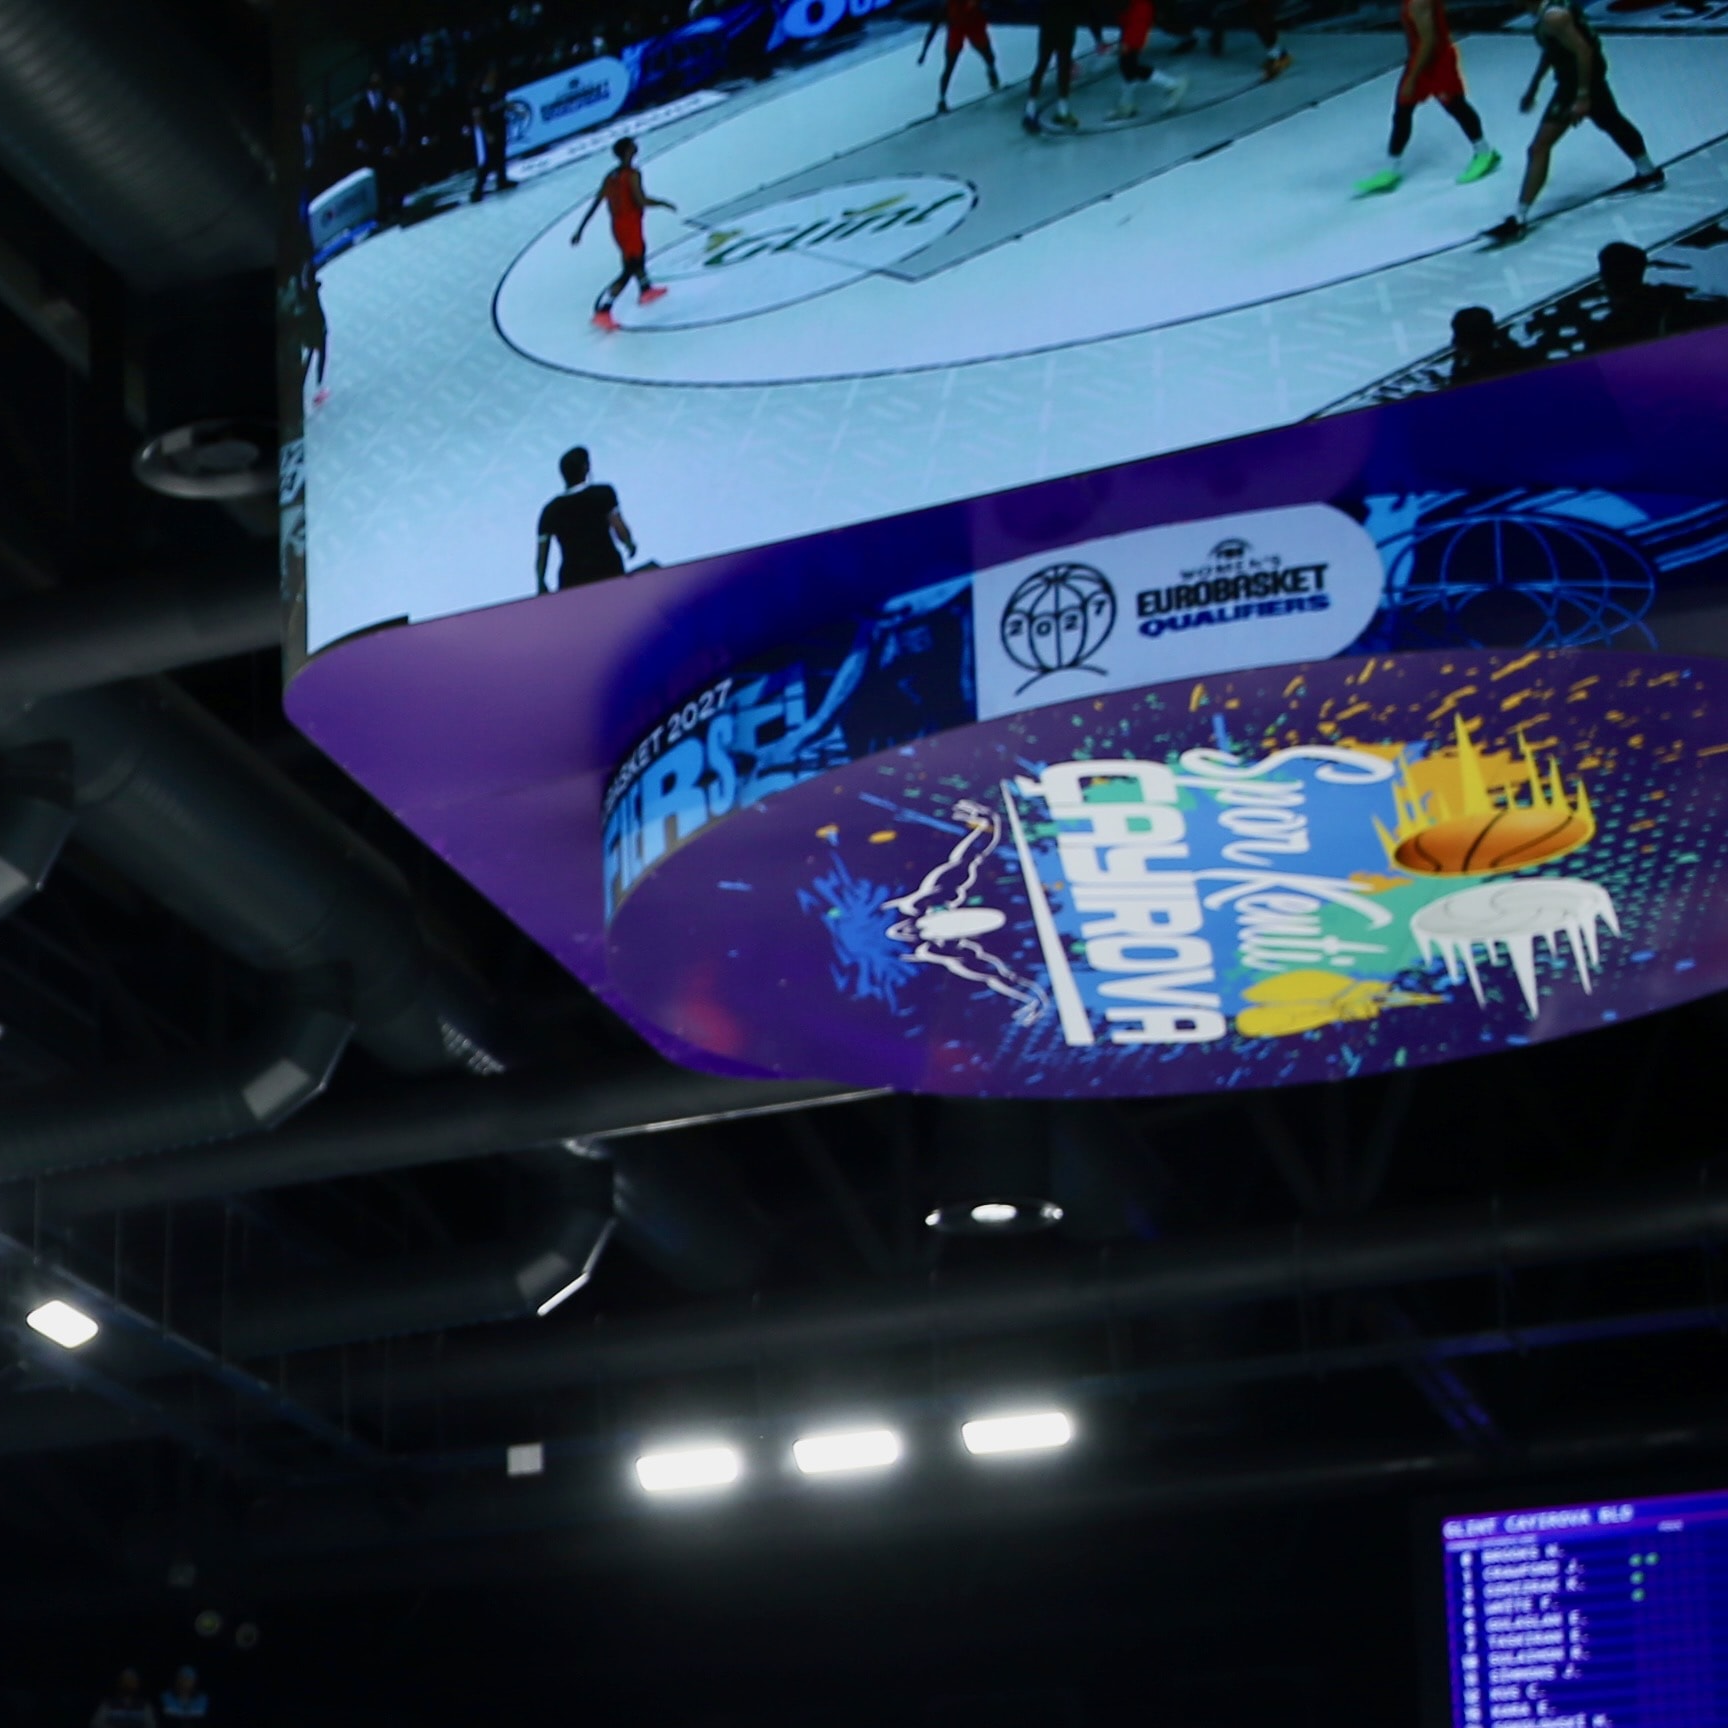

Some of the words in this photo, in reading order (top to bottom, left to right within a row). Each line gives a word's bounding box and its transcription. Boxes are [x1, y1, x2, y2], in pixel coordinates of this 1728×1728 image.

[1136, 563, 1329, 619] EUROBASKET
[1139, 593, 1332, 638] QUALIFIERS
[667, 678, 734, 743] 2027
